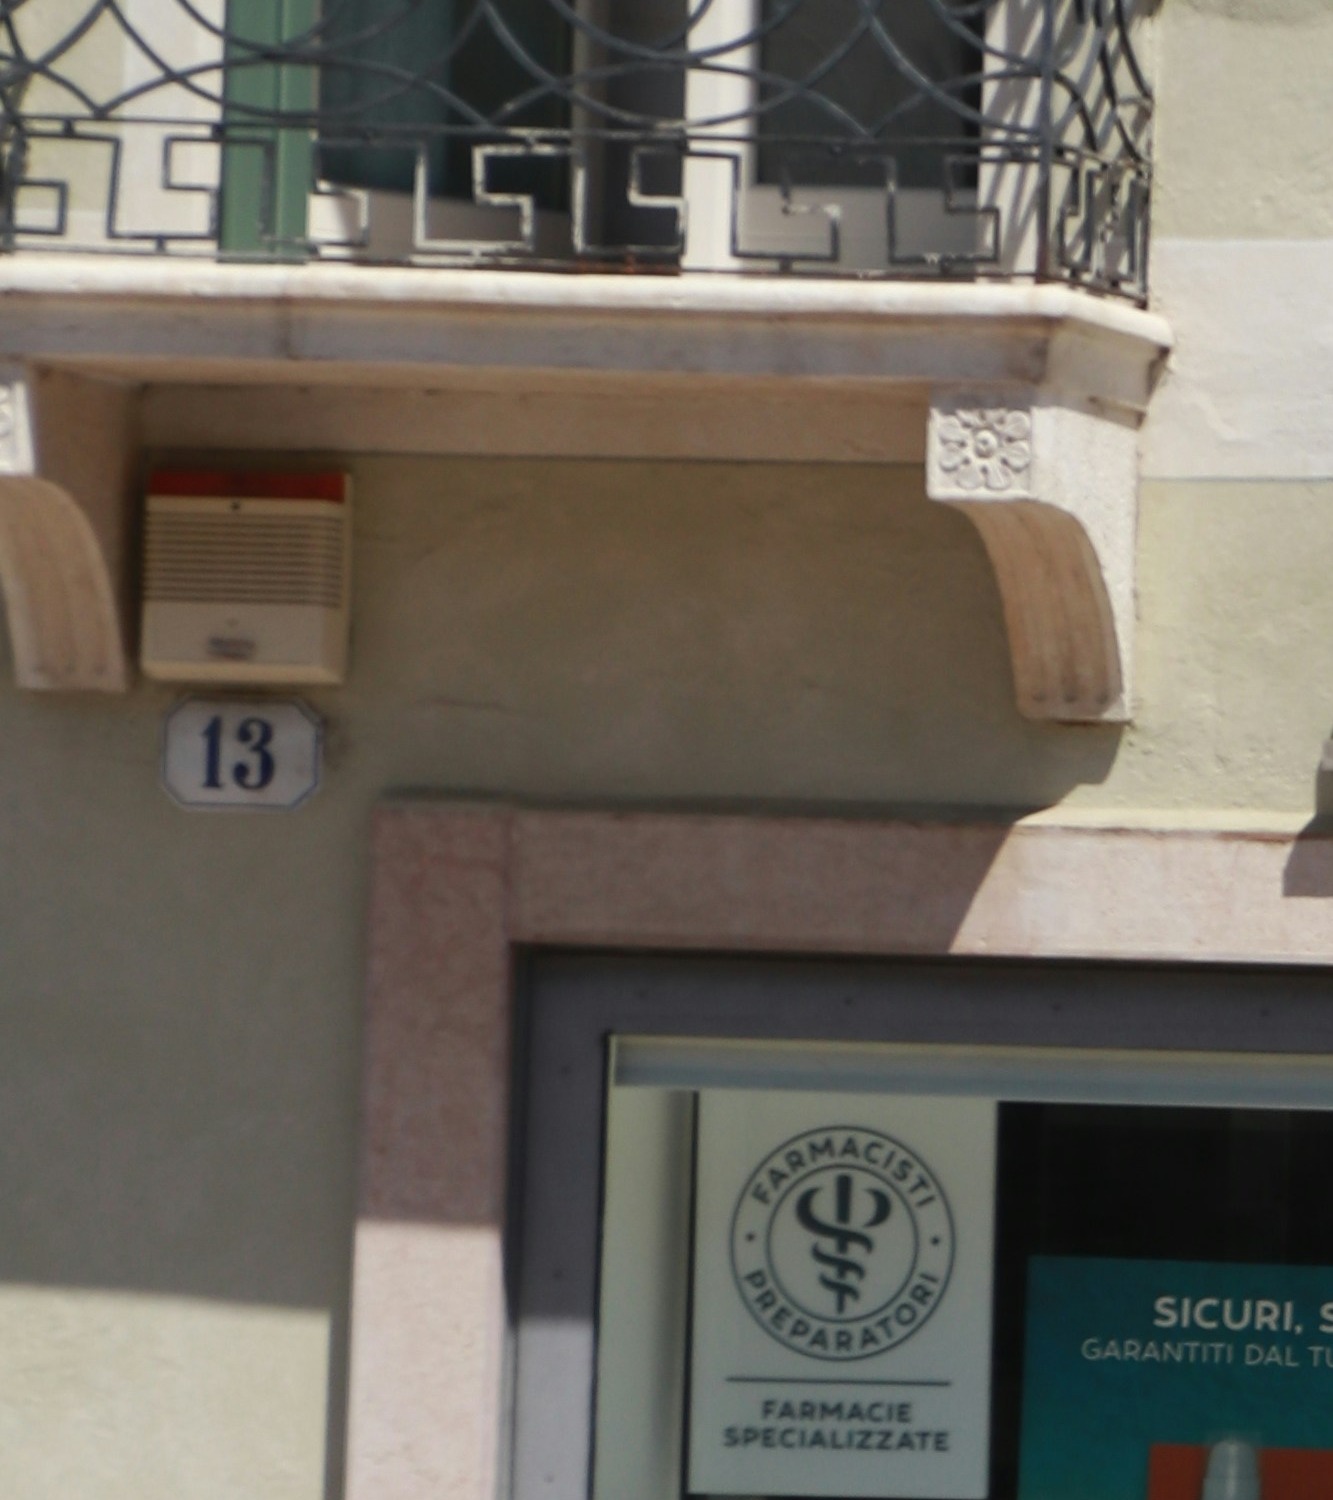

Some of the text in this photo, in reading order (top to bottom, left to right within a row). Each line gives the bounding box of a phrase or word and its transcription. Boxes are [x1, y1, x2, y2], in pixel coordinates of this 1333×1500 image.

[201, 715, 275, 791] 13
[753, 1137, 937, 1208] FARMACISTI
[744, 1269, 940, 1351] PREPARATORI
[1153, 1296, 1304, 1335] SICURI,
[1081, 1337, 1235, 1364] GARANTITI
[1244, 1343, 1300, 1368] DAL
[762, 1400, 912, 1424] FARMACIE
[724, 1426, 949, 1452] SPECIALIZZATE
